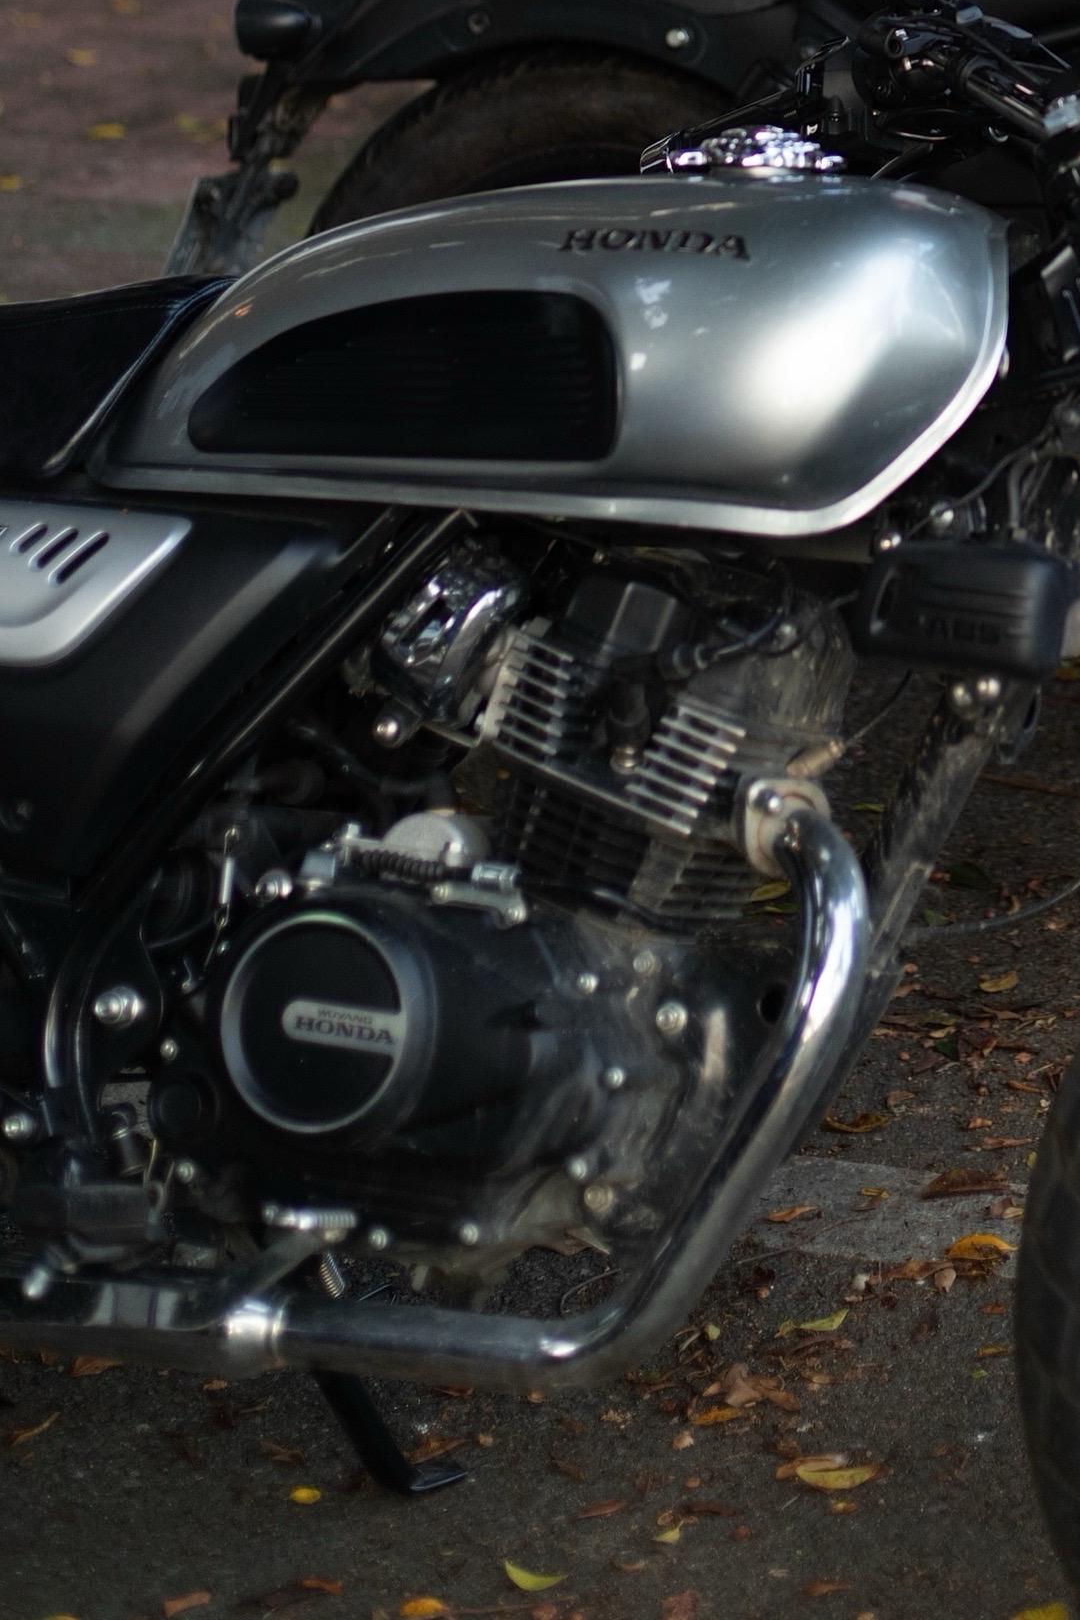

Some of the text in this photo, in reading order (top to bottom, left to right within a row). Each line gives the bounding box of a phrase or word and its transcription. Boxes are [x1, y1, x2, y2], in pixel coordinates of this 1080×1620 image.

[558, 228, 752, 262] HONDA
[295, 1016, 394, 1044] HONDA
[319, 1009, 373, 1024] WUYANG
